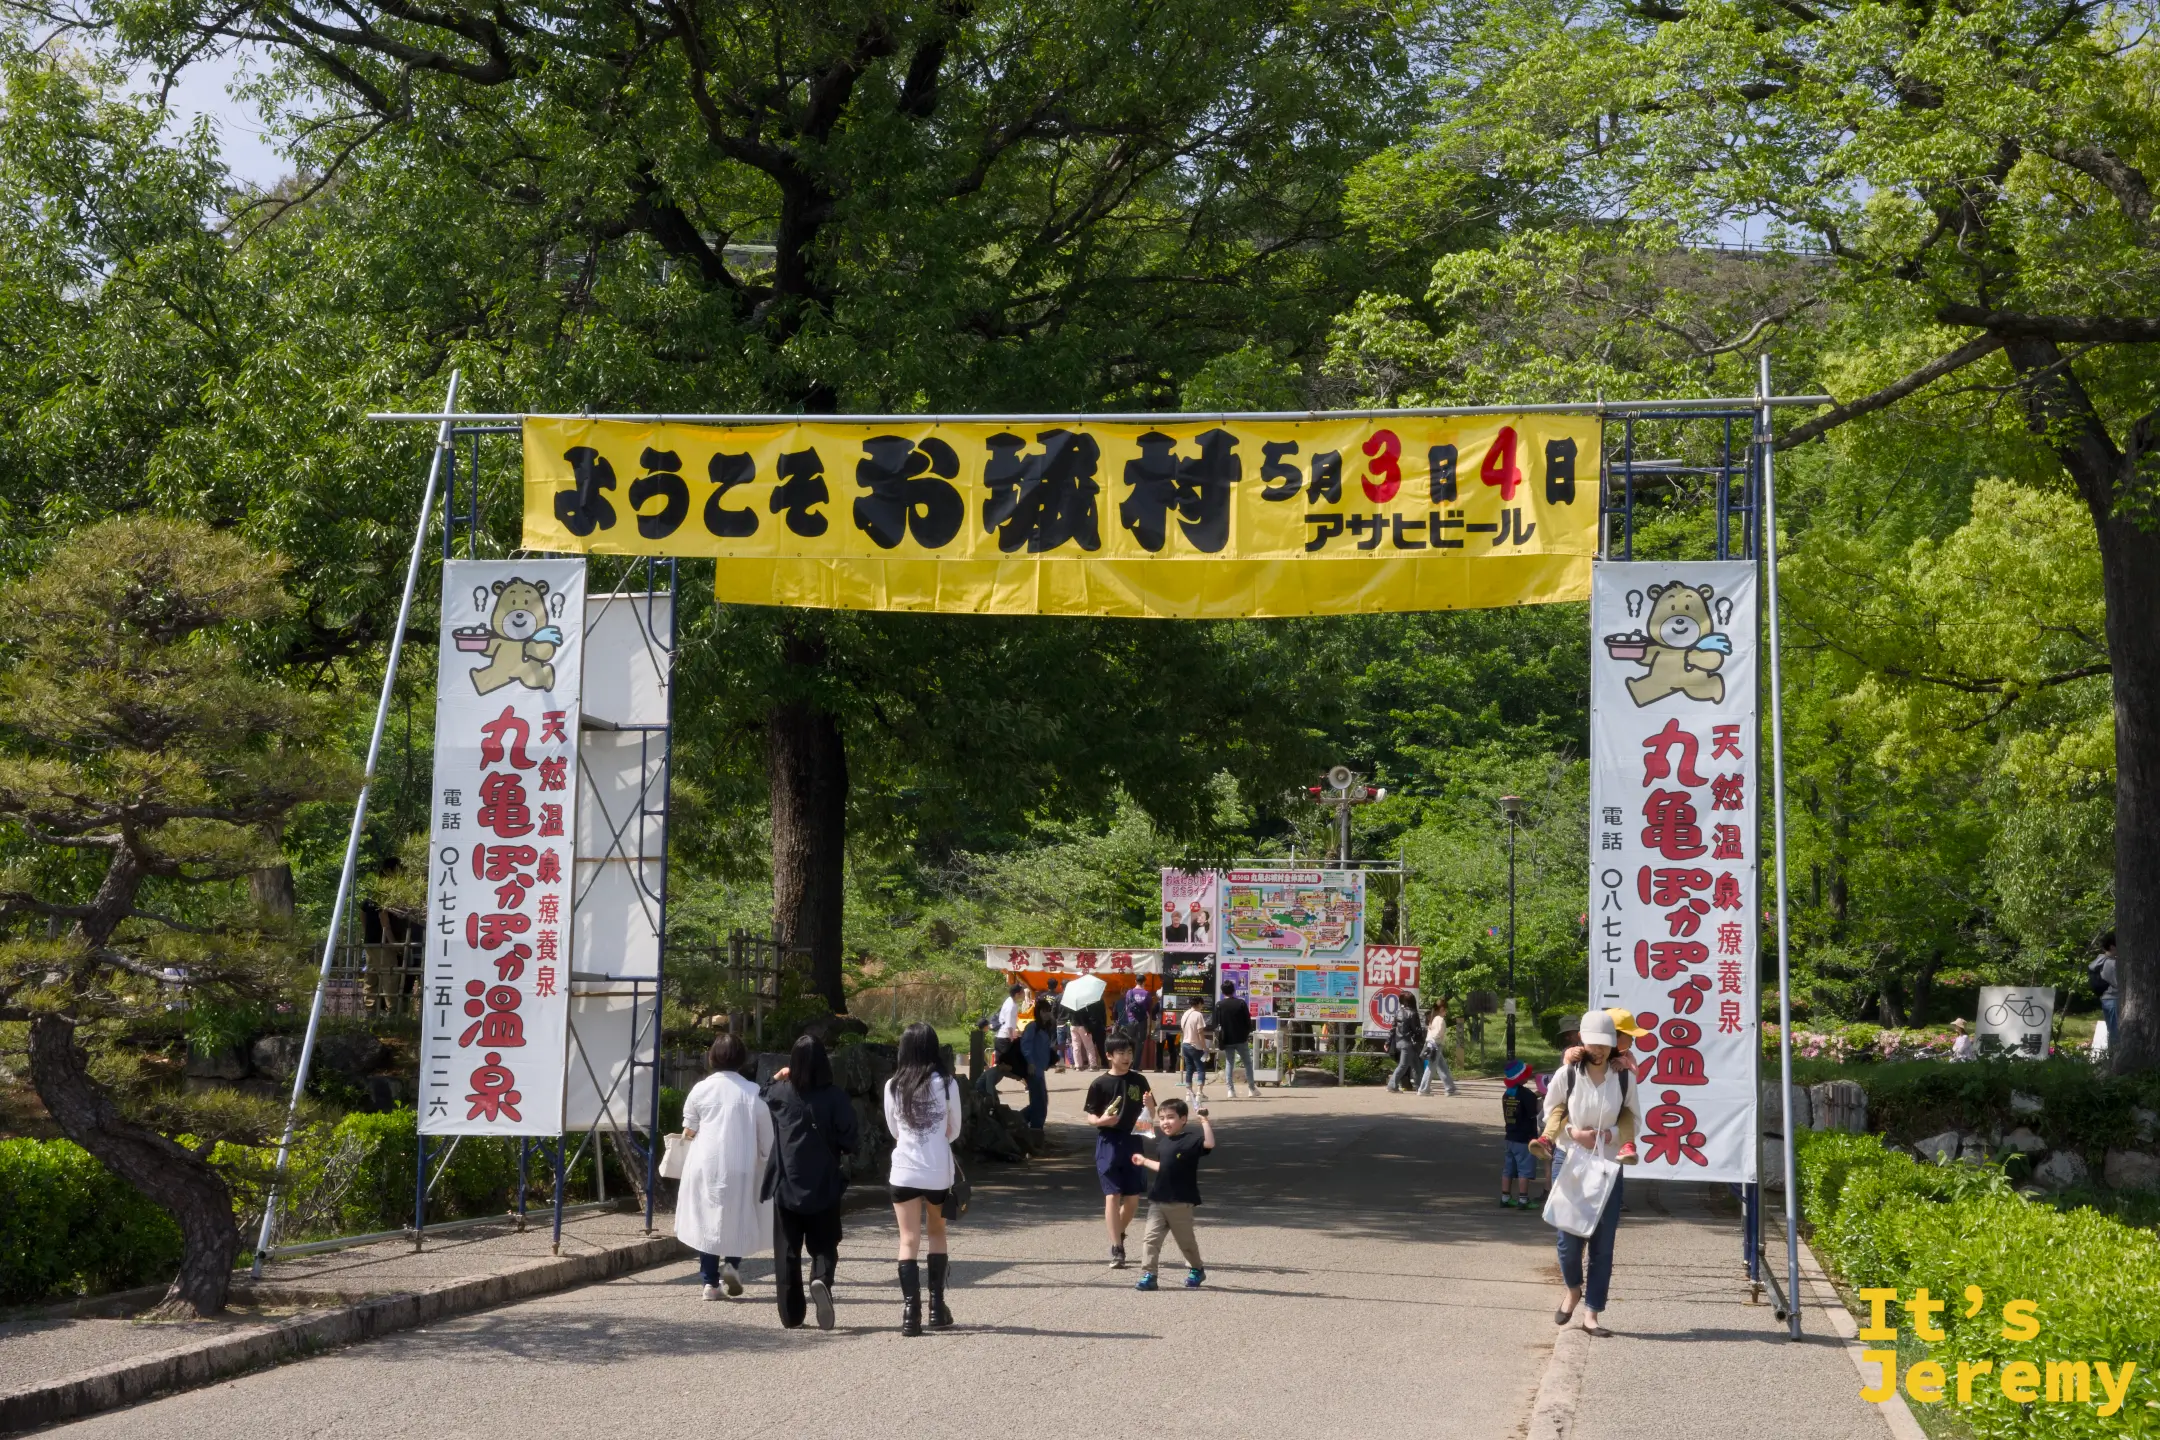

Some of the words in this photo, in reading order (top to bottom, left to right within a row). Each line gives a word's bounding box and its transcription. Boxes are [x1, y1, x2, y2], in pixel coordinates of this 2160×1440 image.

[1303, 509, 1537, 553] アサヒビール
[441, 788, 462, 831] 電話
[1601, 805, 1623, 852] 電話
[458, 705, 538, 1123] 丸亀ぽかぽか温泉
[1635, 718, 1713, 1167] 丸亀ぽかぽか温泉
[1366, 948, 1419, 986] 徐行
[1373, 993, 1399, 1015] 10
